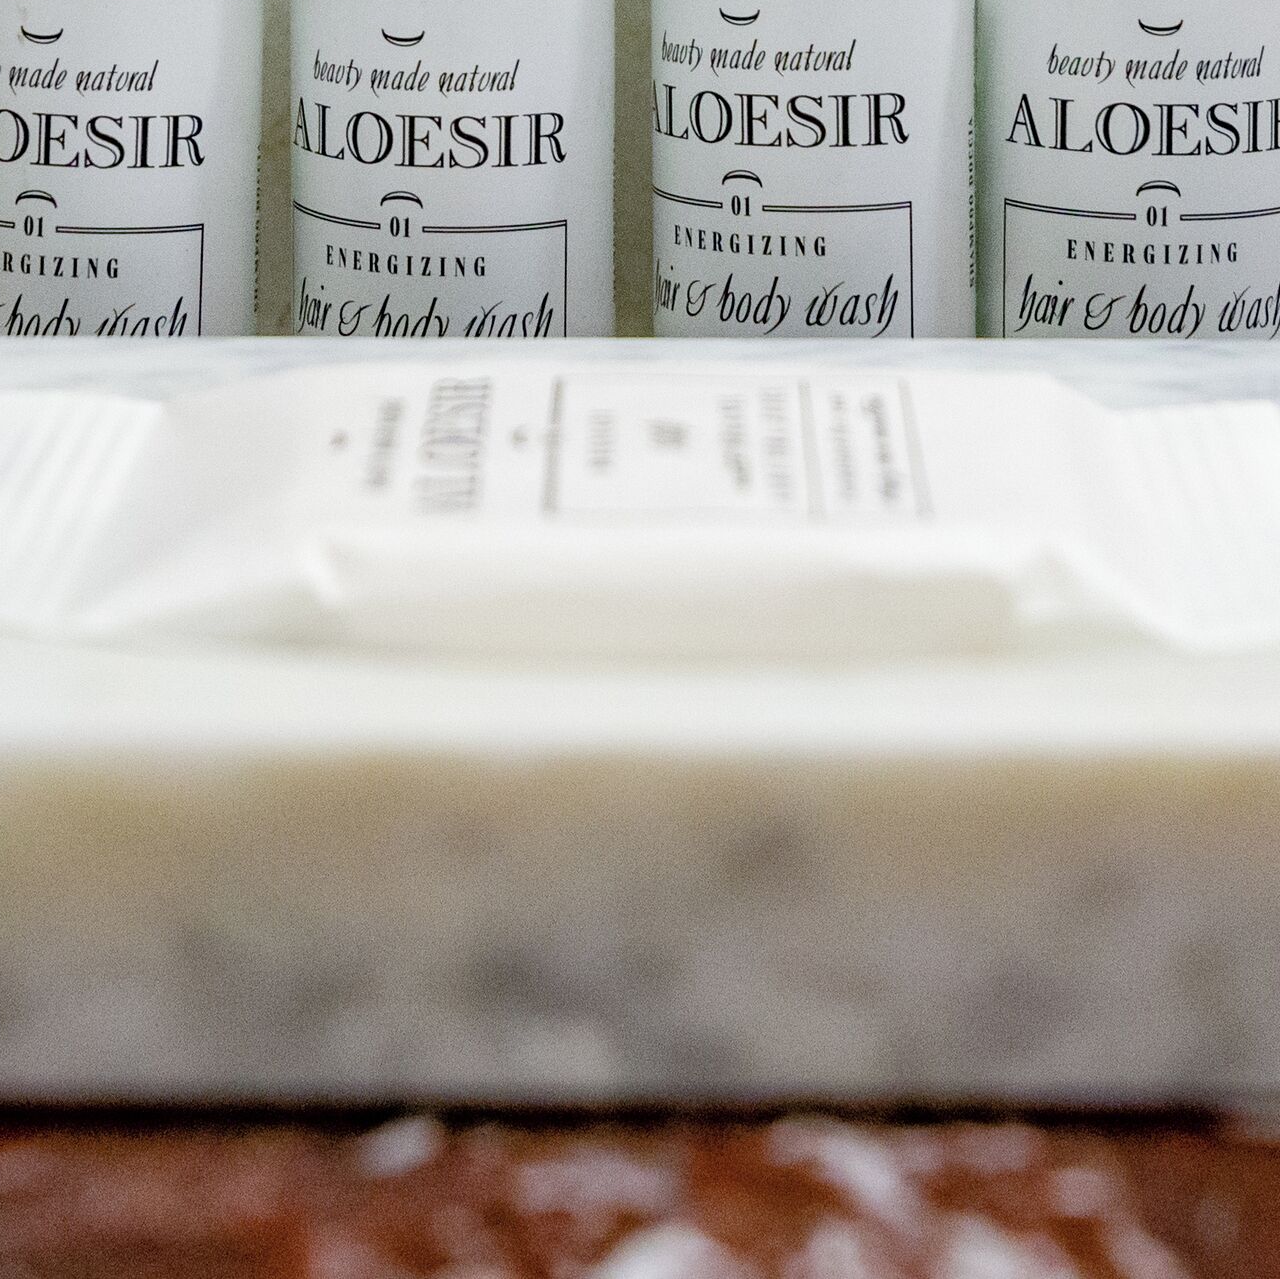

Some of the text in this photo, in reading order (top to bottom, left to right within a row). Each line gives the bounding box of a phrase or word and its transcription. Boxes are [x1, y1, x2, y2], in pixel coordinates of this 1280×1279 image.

[661, 30, 856, 77] beauty made natural
[1046, 43, 1265, 88] beauty made natural
[8, 57, 67, 96] made
[75, 59, 159, 97] natural
[313, 49, 520, 98] beauty made natural
[293, 96, 568, 169] ALOESIR
[731, 194, 751, 217] 01
[1146, 205, 1168, 227] 01
[23, 215, 44, 238] 01
[389, 216, 411, 238] 01
[674, 224, 826, 257] ENERGIZING
[326, 244, 486, 277] ENERGIZING
[1067, 239, 1238, 265] ENERGIZING
[338, 299, 371, 337] &
[685, 279, 718, 317] &
[716, 272, 791, 335] body
[804, 272, 899, 337] wash
[1014, 272, 1075, 332] hair
[1083, 292, 1128, 331] &
[1125, 284, 1206, 337] body
